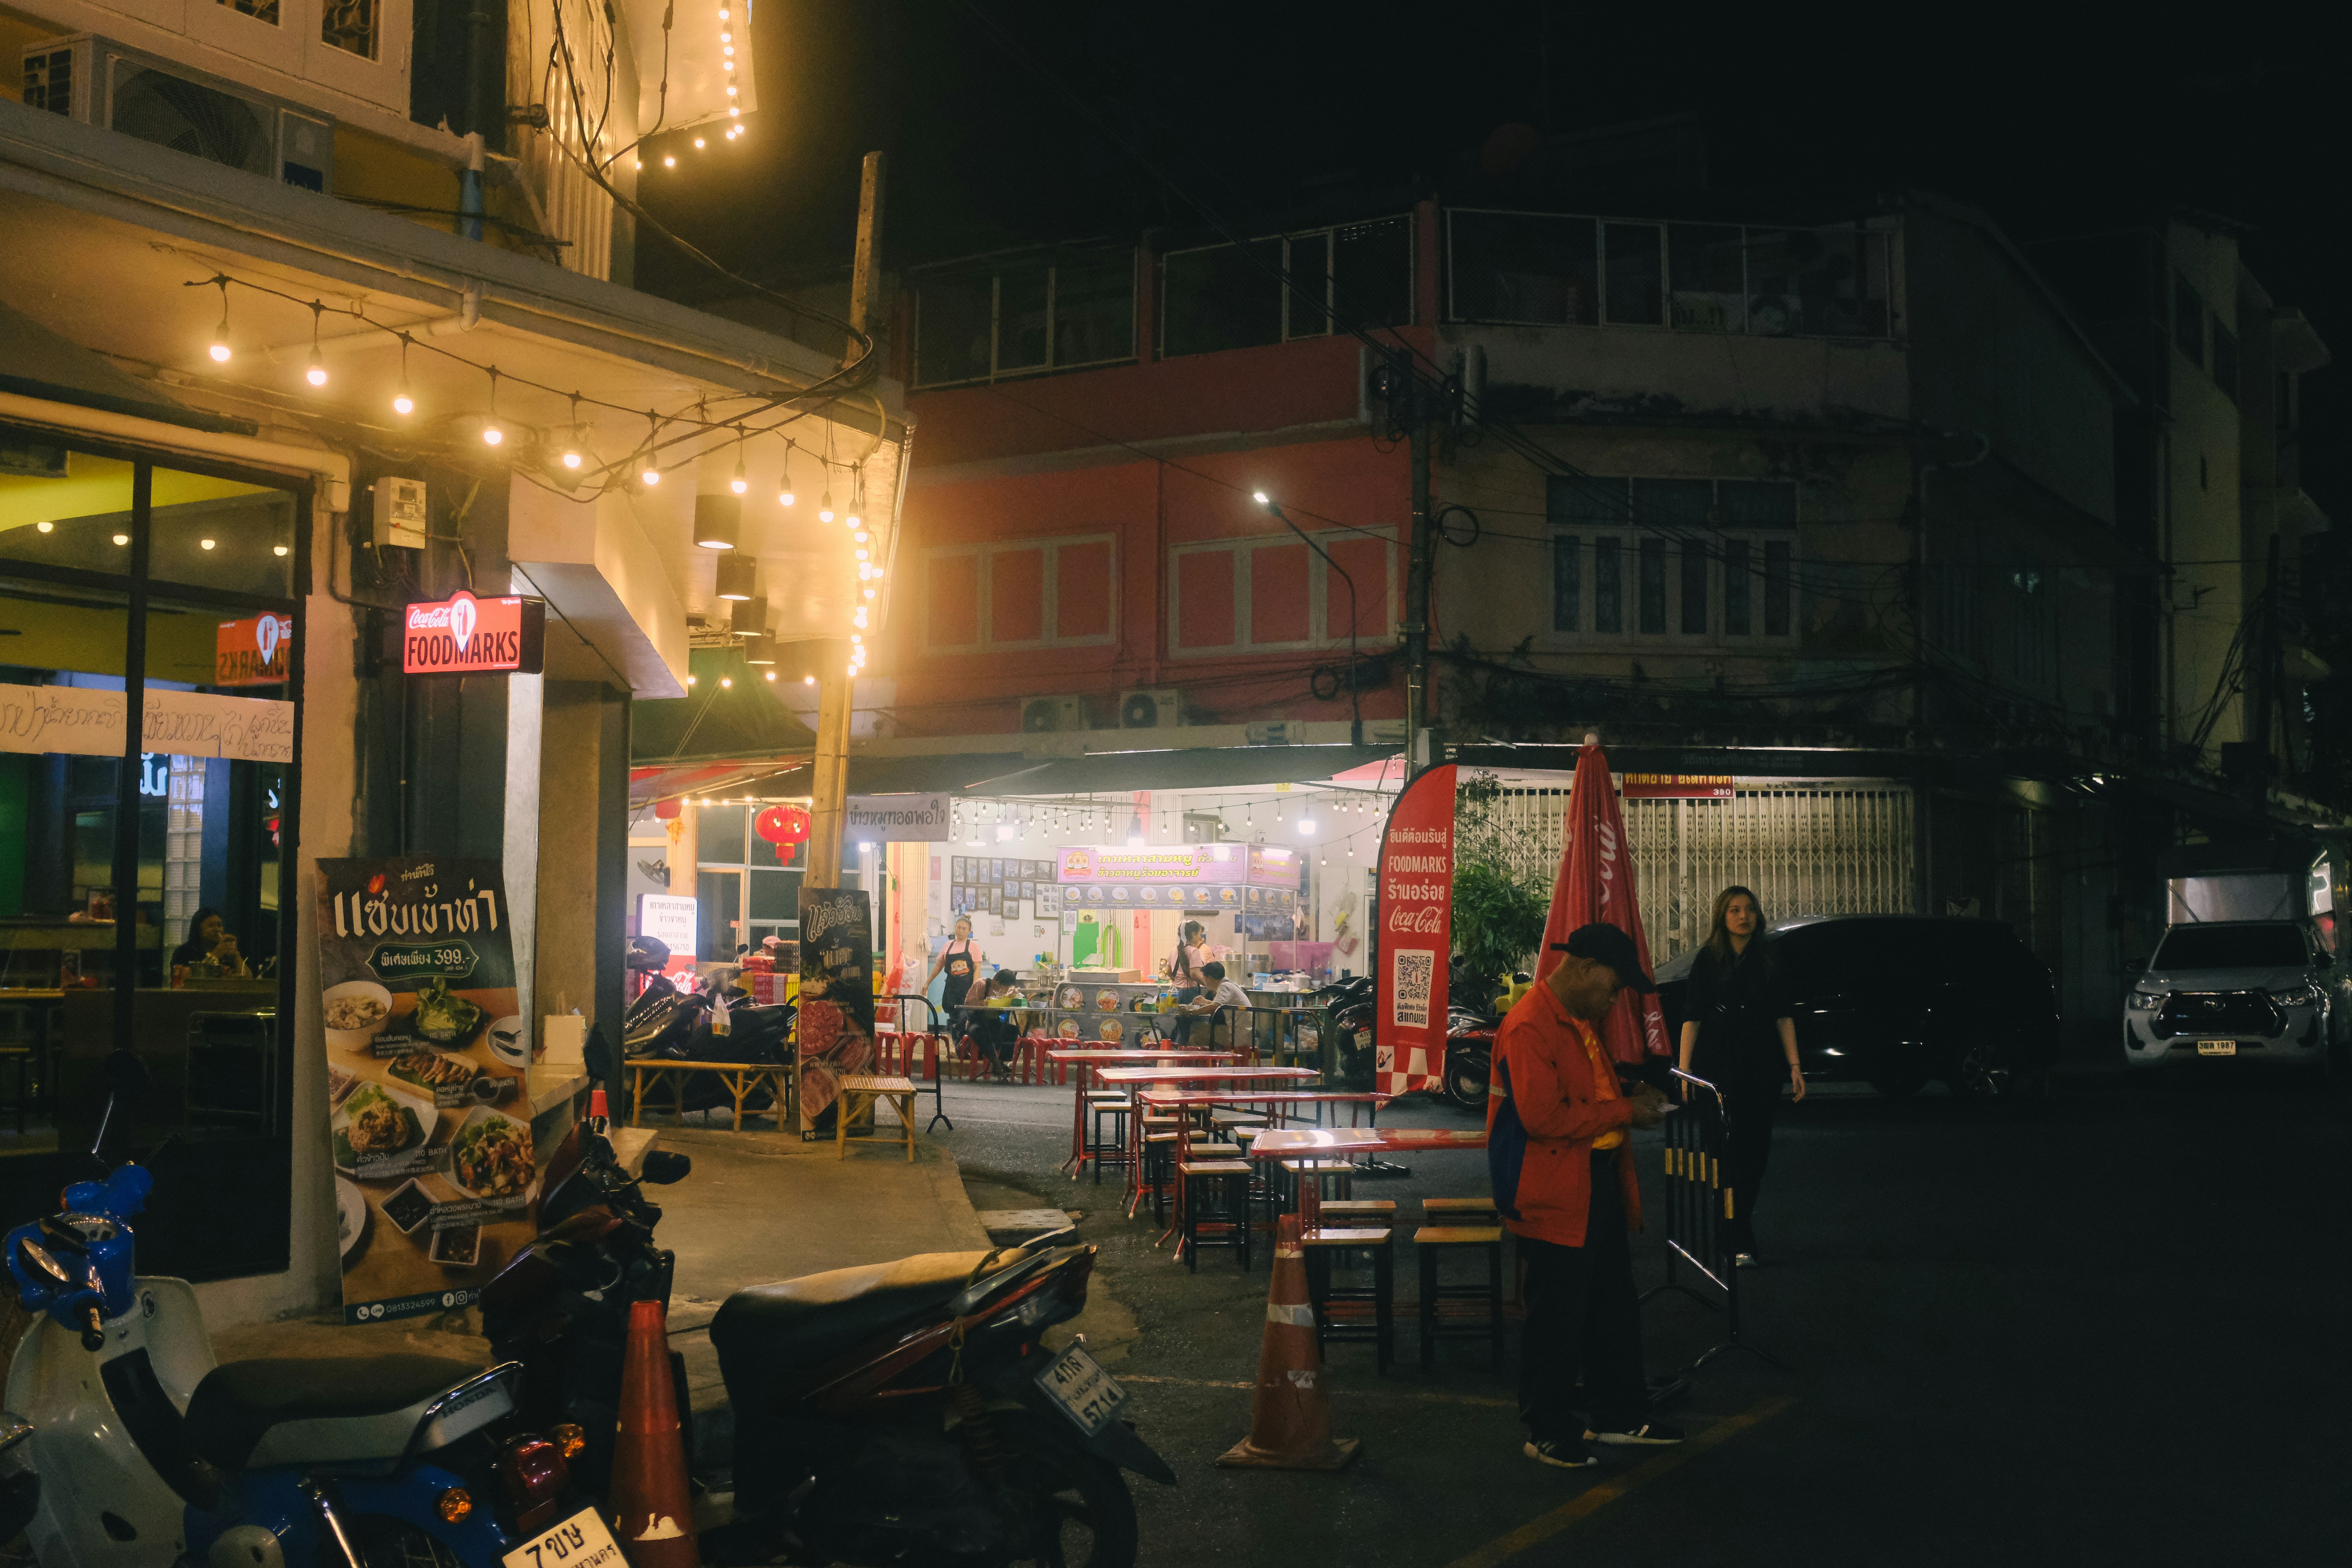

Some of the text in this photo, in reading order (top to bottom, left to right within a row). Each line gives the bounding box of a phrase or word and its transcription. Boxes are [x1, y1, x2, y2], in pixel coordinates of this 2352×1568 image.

[409, 608, 451, 629] Coca-Cola
[408, 631, 518, 666] FOODMARKS
[850, 799, 945, 831] ข้าวหมูทอดพอใจ
[1098, 853, 1193, 866] เกาเหลาสามหมู
[1389, 856, 1446, 873] FOODMARKS
[1388, 878, 1445, 901] ร้านอร่อย
[650, 901, 695, 915] เกาเหลาสามหมู
[1389, 905, 1443, 934] Coca-Cola
[1397, 1012, 1426, 1025] สแกนเลย
[428, 1147, 447, 1156] BATH
[506, 1196, 524, 1205] BATH
[1082, 1387, 1118, 1427] 5714
